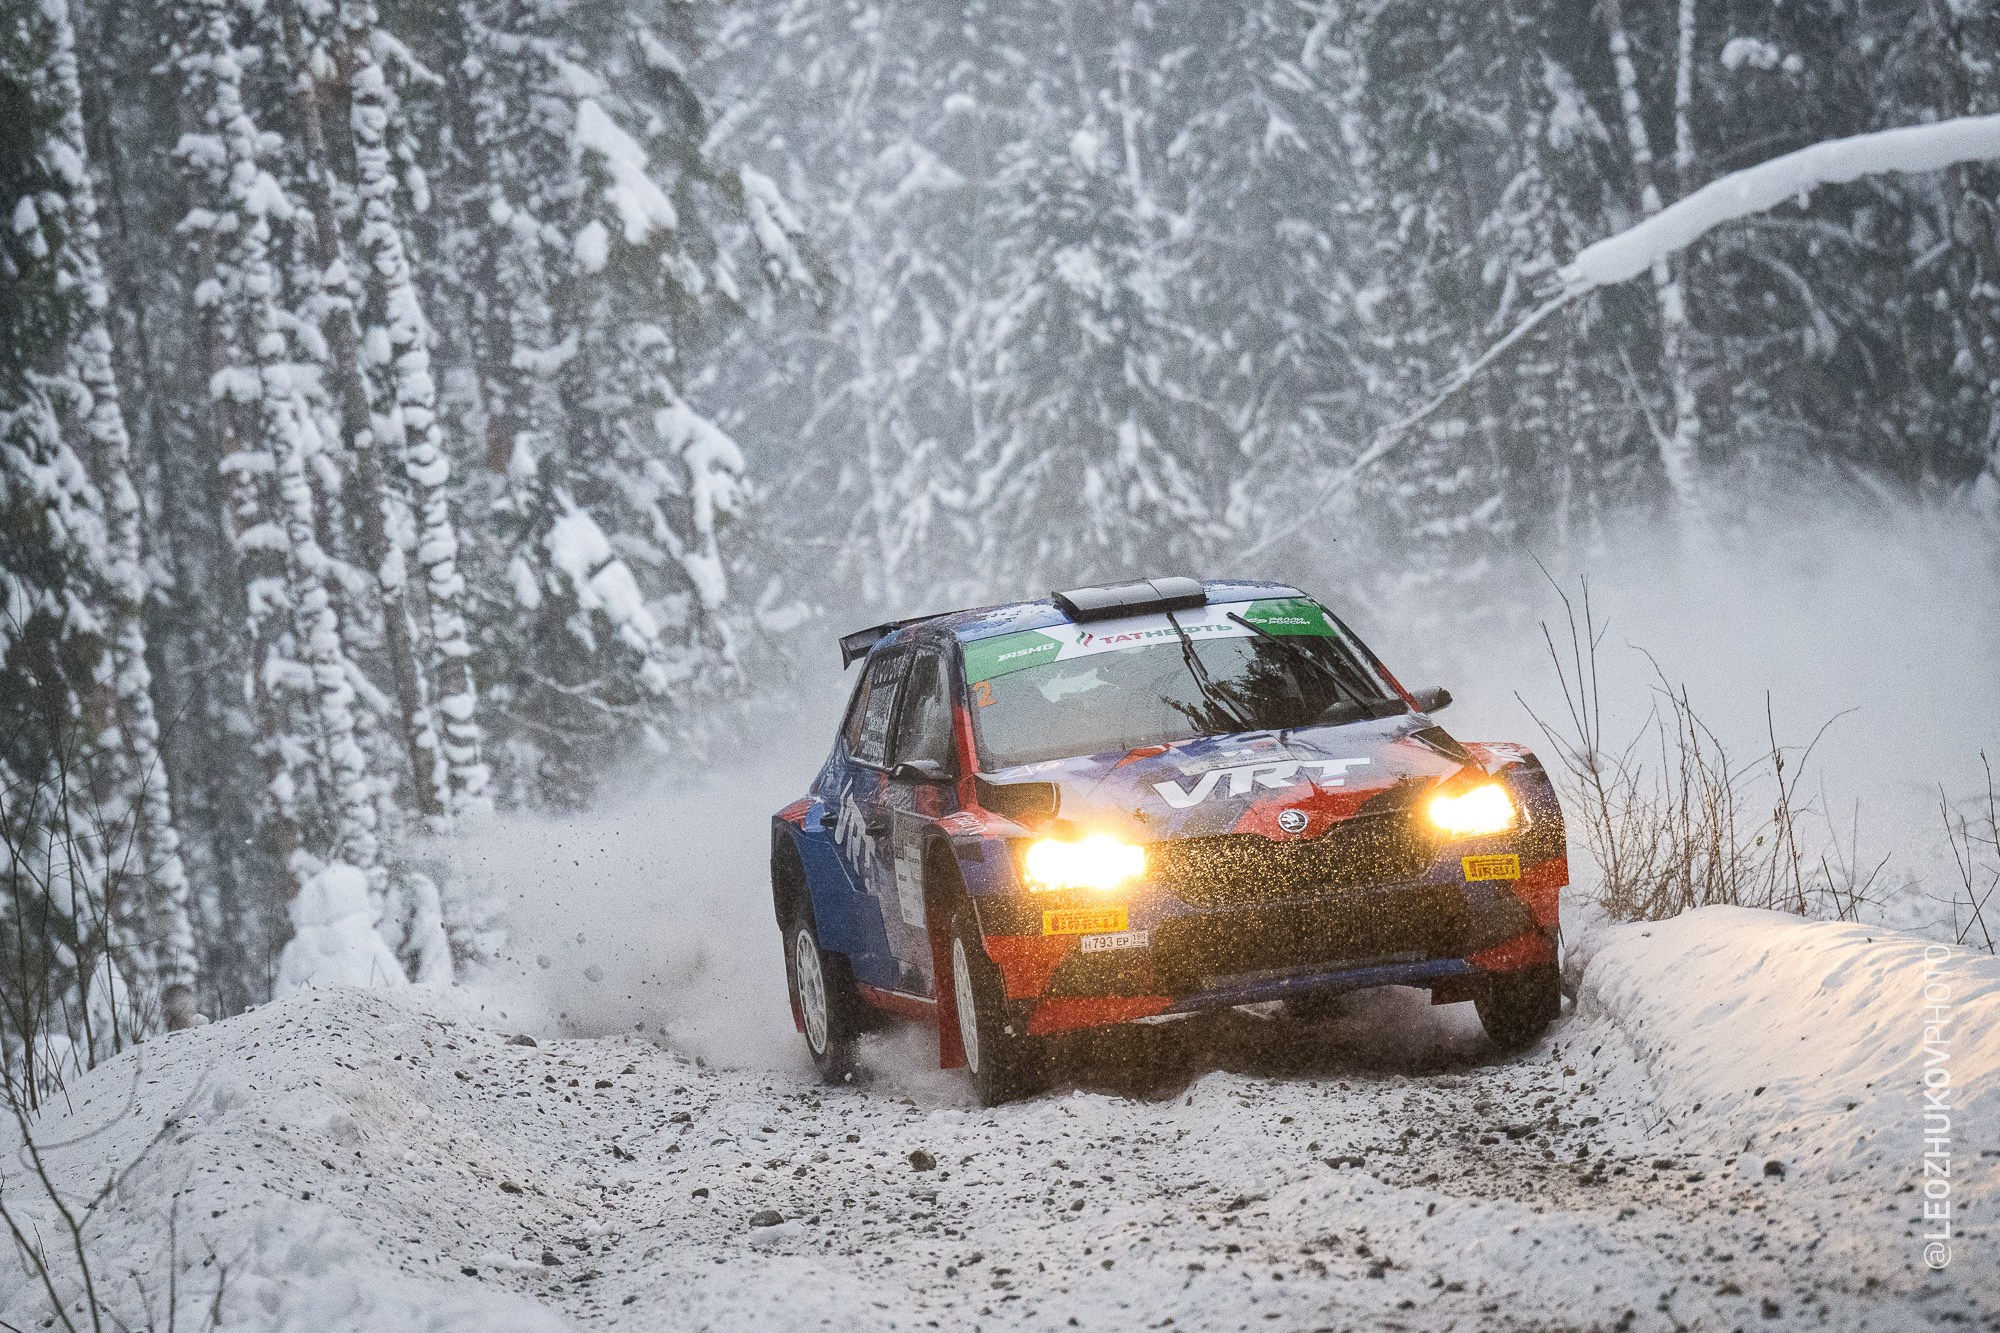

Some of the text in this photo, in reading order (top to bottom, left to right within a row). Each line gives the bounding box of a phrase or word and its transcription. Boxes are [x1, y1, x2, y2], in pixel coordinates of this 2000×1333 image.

[1099, 624, 1233, 645] ТАТНЕФТЬ
[972, 681, 998, 708] 2
[1154, 757, 1371, 809] VRT
